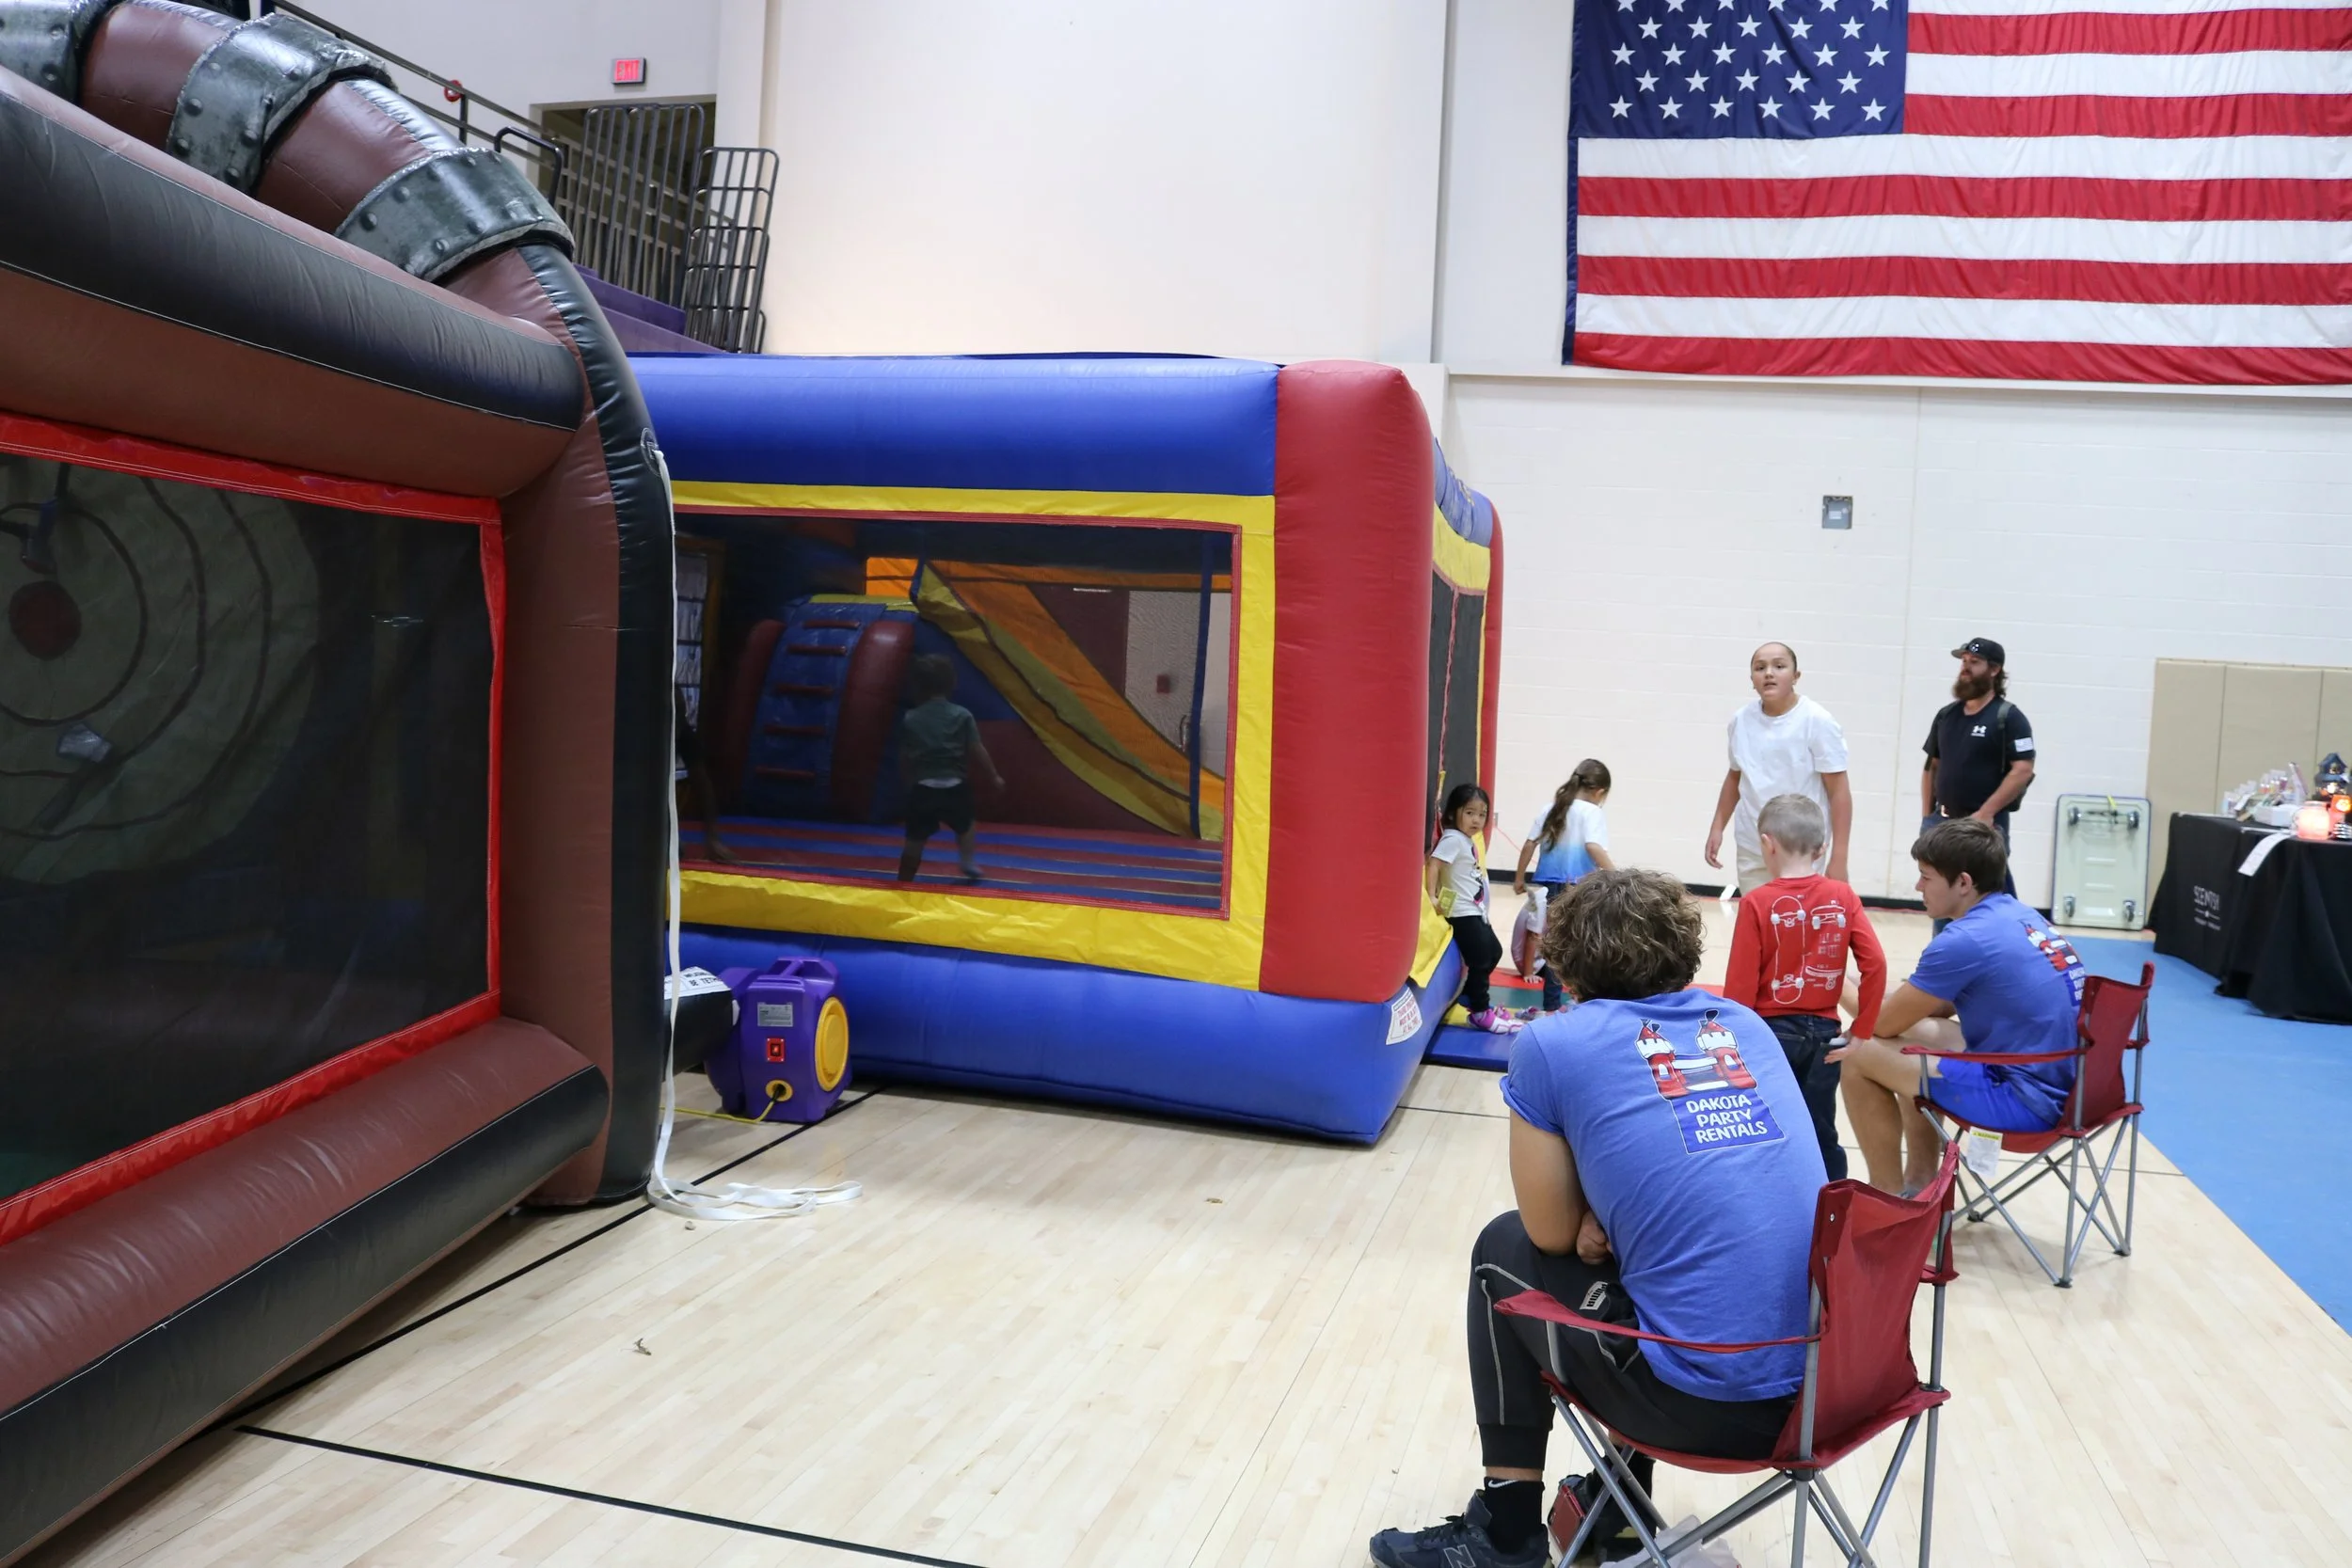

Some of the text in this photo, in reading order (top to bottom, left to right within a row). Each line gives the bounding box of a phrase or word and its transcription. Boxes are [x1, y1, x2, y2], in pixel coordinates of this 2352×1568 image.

[615, 60, 641, 81] EXIT
[1685, 1094, 1752, 1114] DAKOTA
[1696, 1108, 1752, 1128] PARTY
[1695, 1121, 1768, 1144] RENTALS
